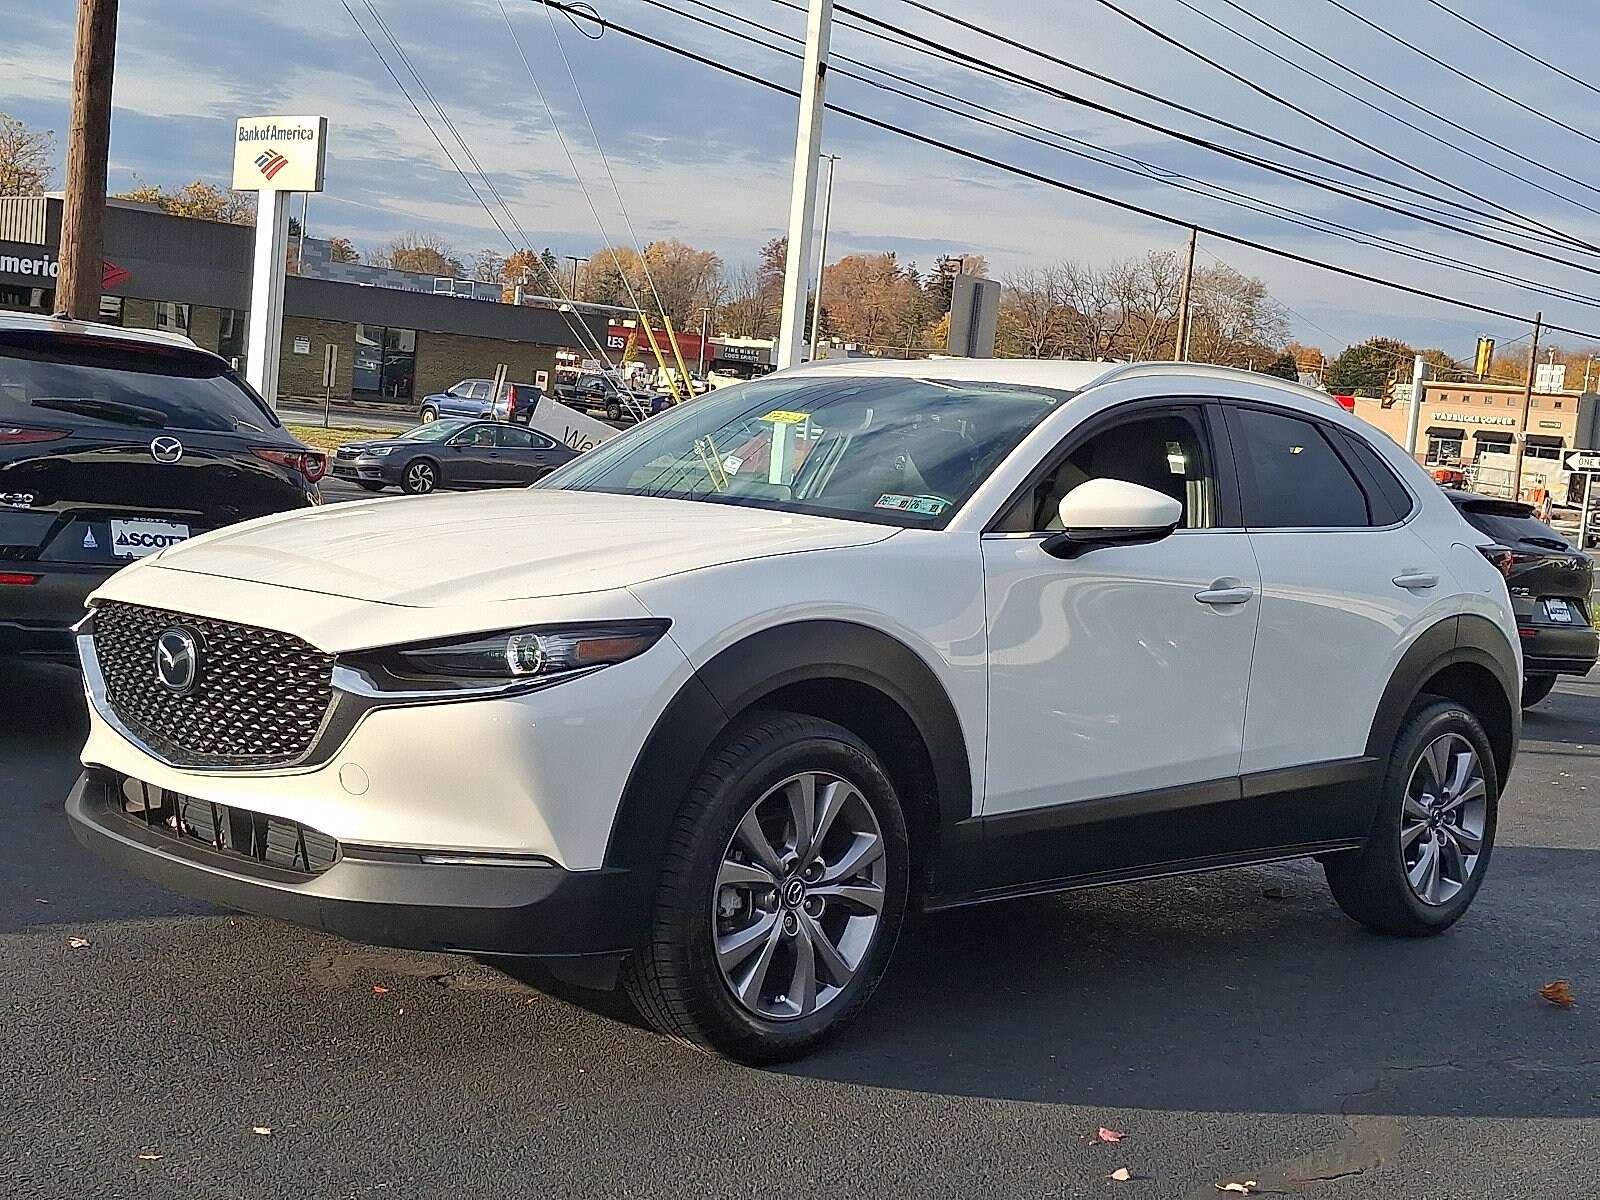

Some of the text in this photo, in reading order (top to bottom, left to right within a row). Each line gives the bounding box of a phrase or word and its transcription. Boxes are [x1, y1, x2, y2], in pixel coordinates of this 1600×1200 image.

[239, 124, 314, 141] Bank of America
[1431, 412, 1516, 427] STARBUCKS COFFEE
[563, 426, 602, 451] We
[1578, 457, 1595, 467] ONE
